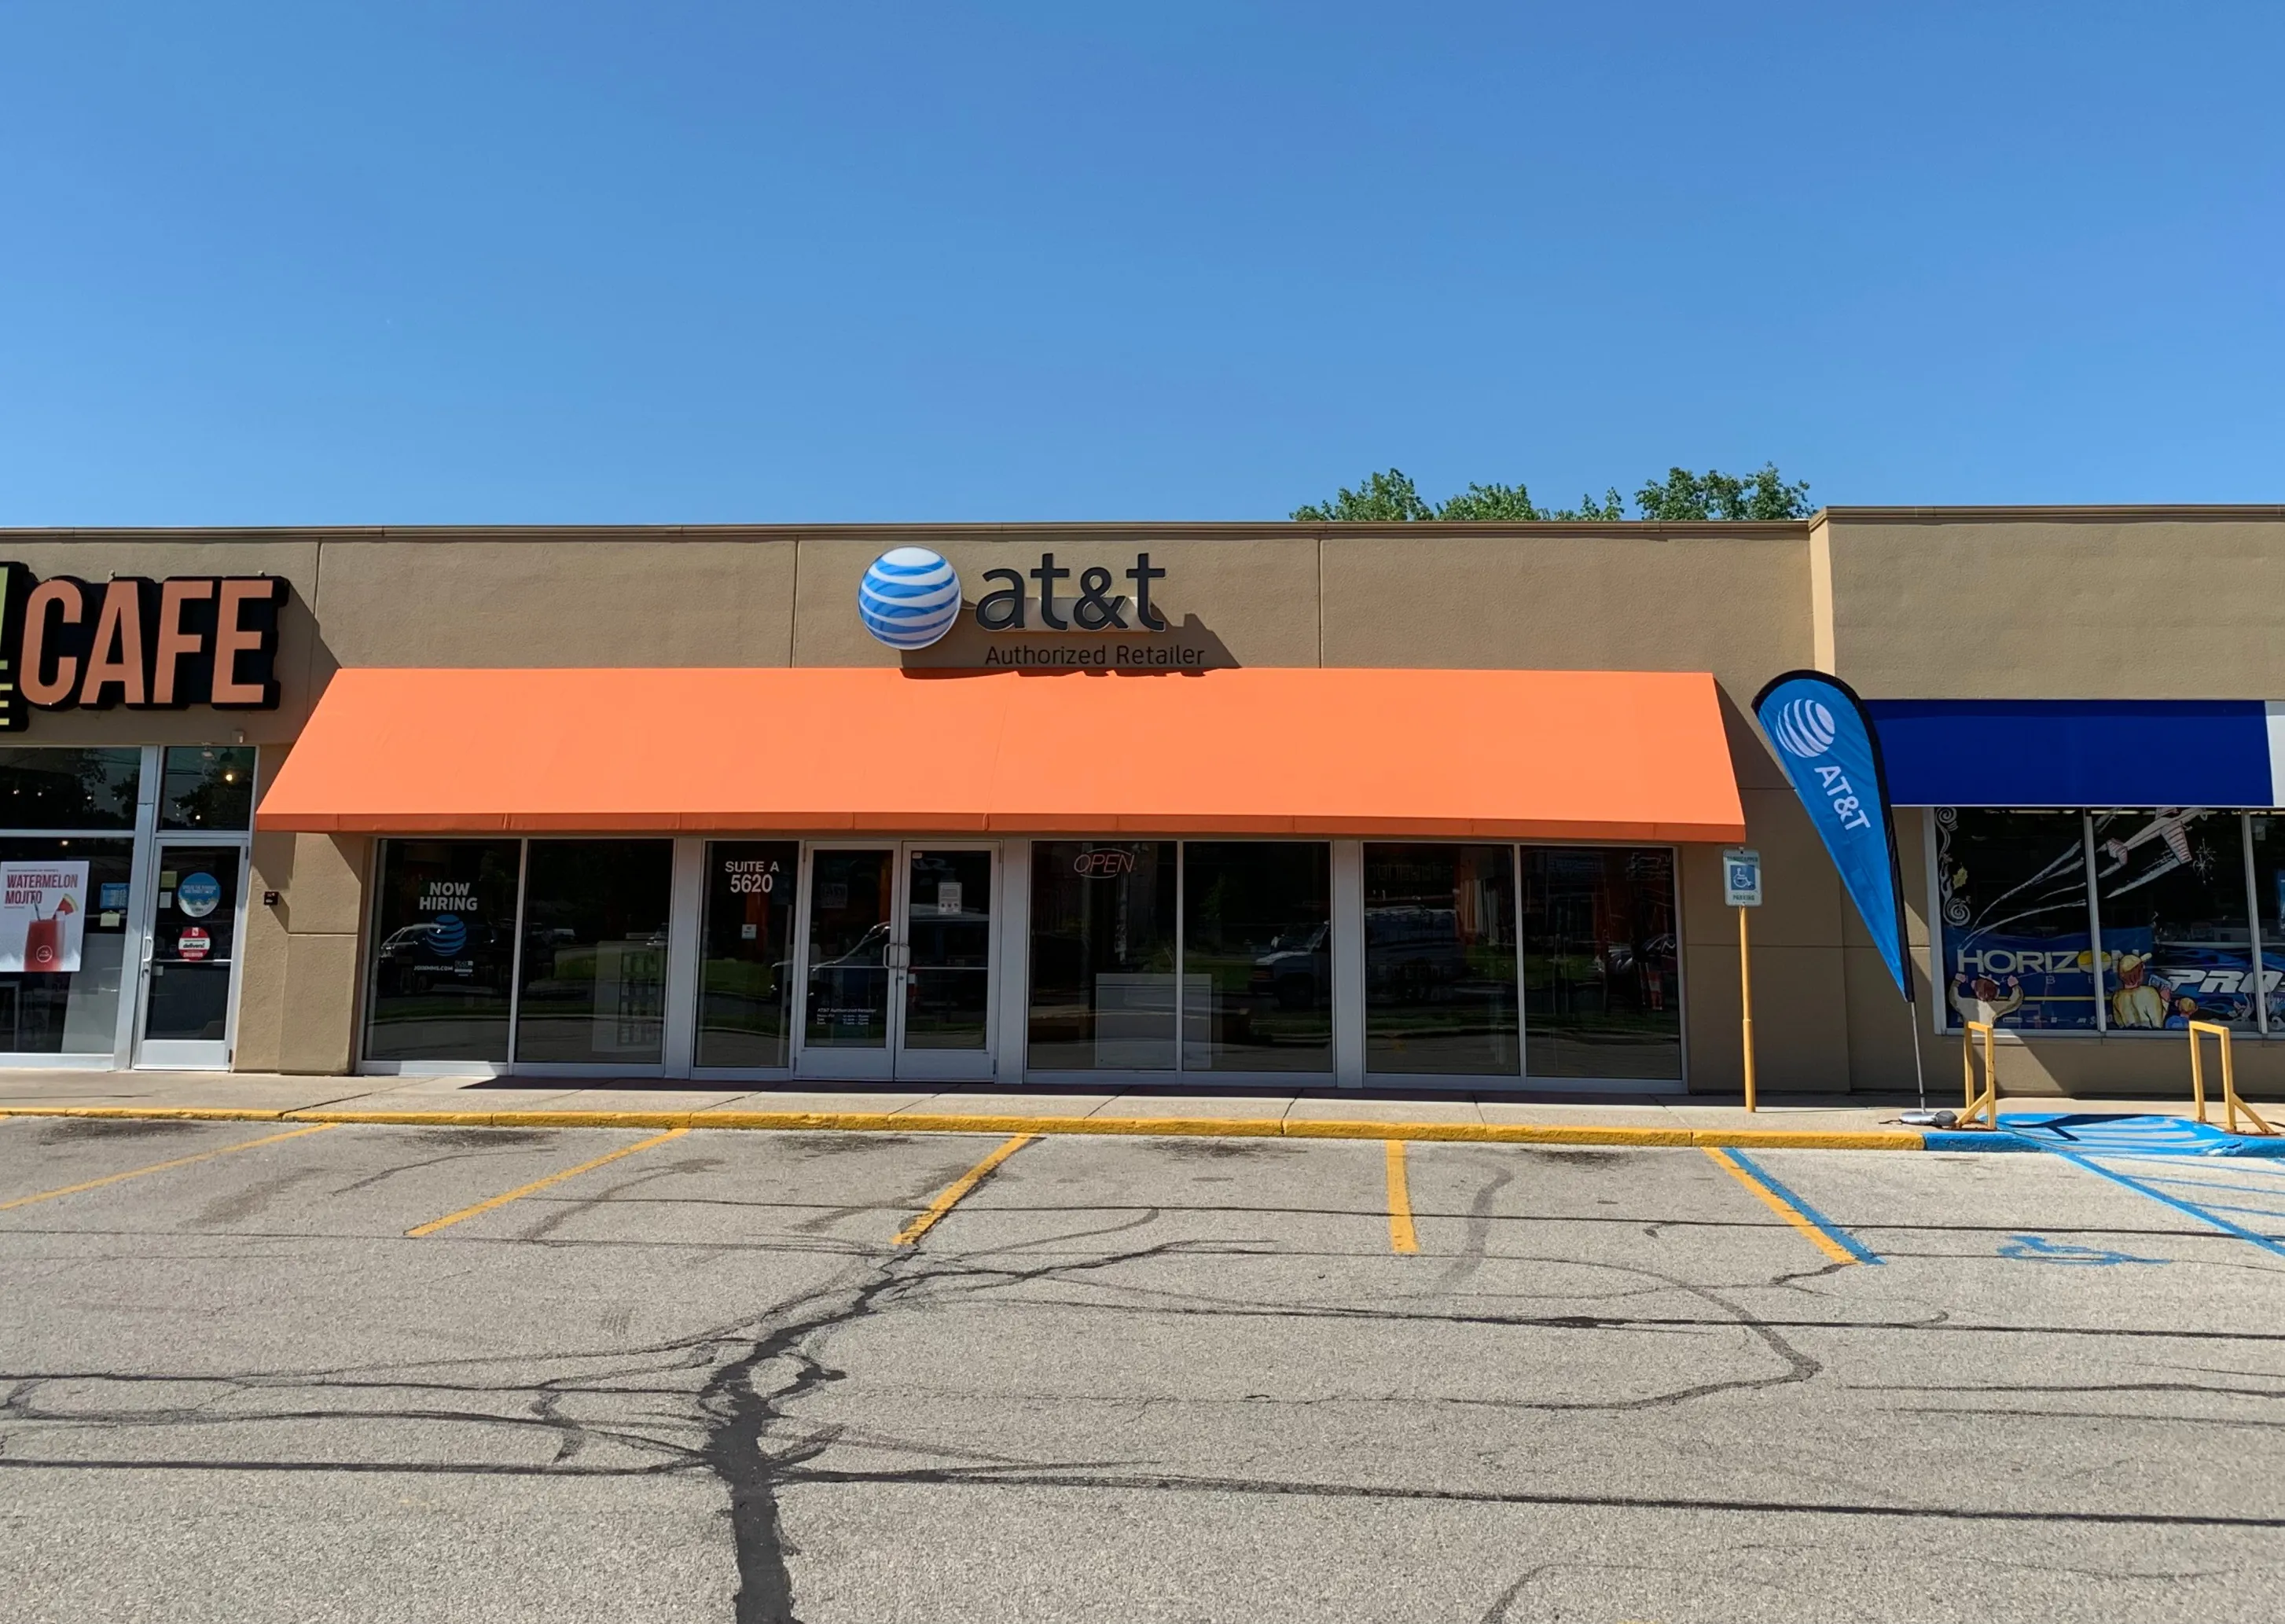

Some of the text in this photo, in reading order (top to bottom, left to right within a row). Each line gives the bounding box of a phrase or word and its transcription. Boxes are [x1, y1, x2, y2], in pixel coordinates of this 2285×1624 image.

[975, 553, 1166, 631] at&t
[20, 579, 274, 705] CAFE
[985, 645, 1205, 665] Authorized Retailer
[1814, 766, 1871, 830] AT&T
[725, 861, 780, 873] SUITE A
[1074, 854, 1134, 873] OPEN
[7, 874, 79, 888] WATERMELON
[429, 882, 471, 896] NOW
[729, 874, 773, 893] 5620
[5, 890, 42, 904] MOJITO
[419, 897, 478, 910] HIRING
